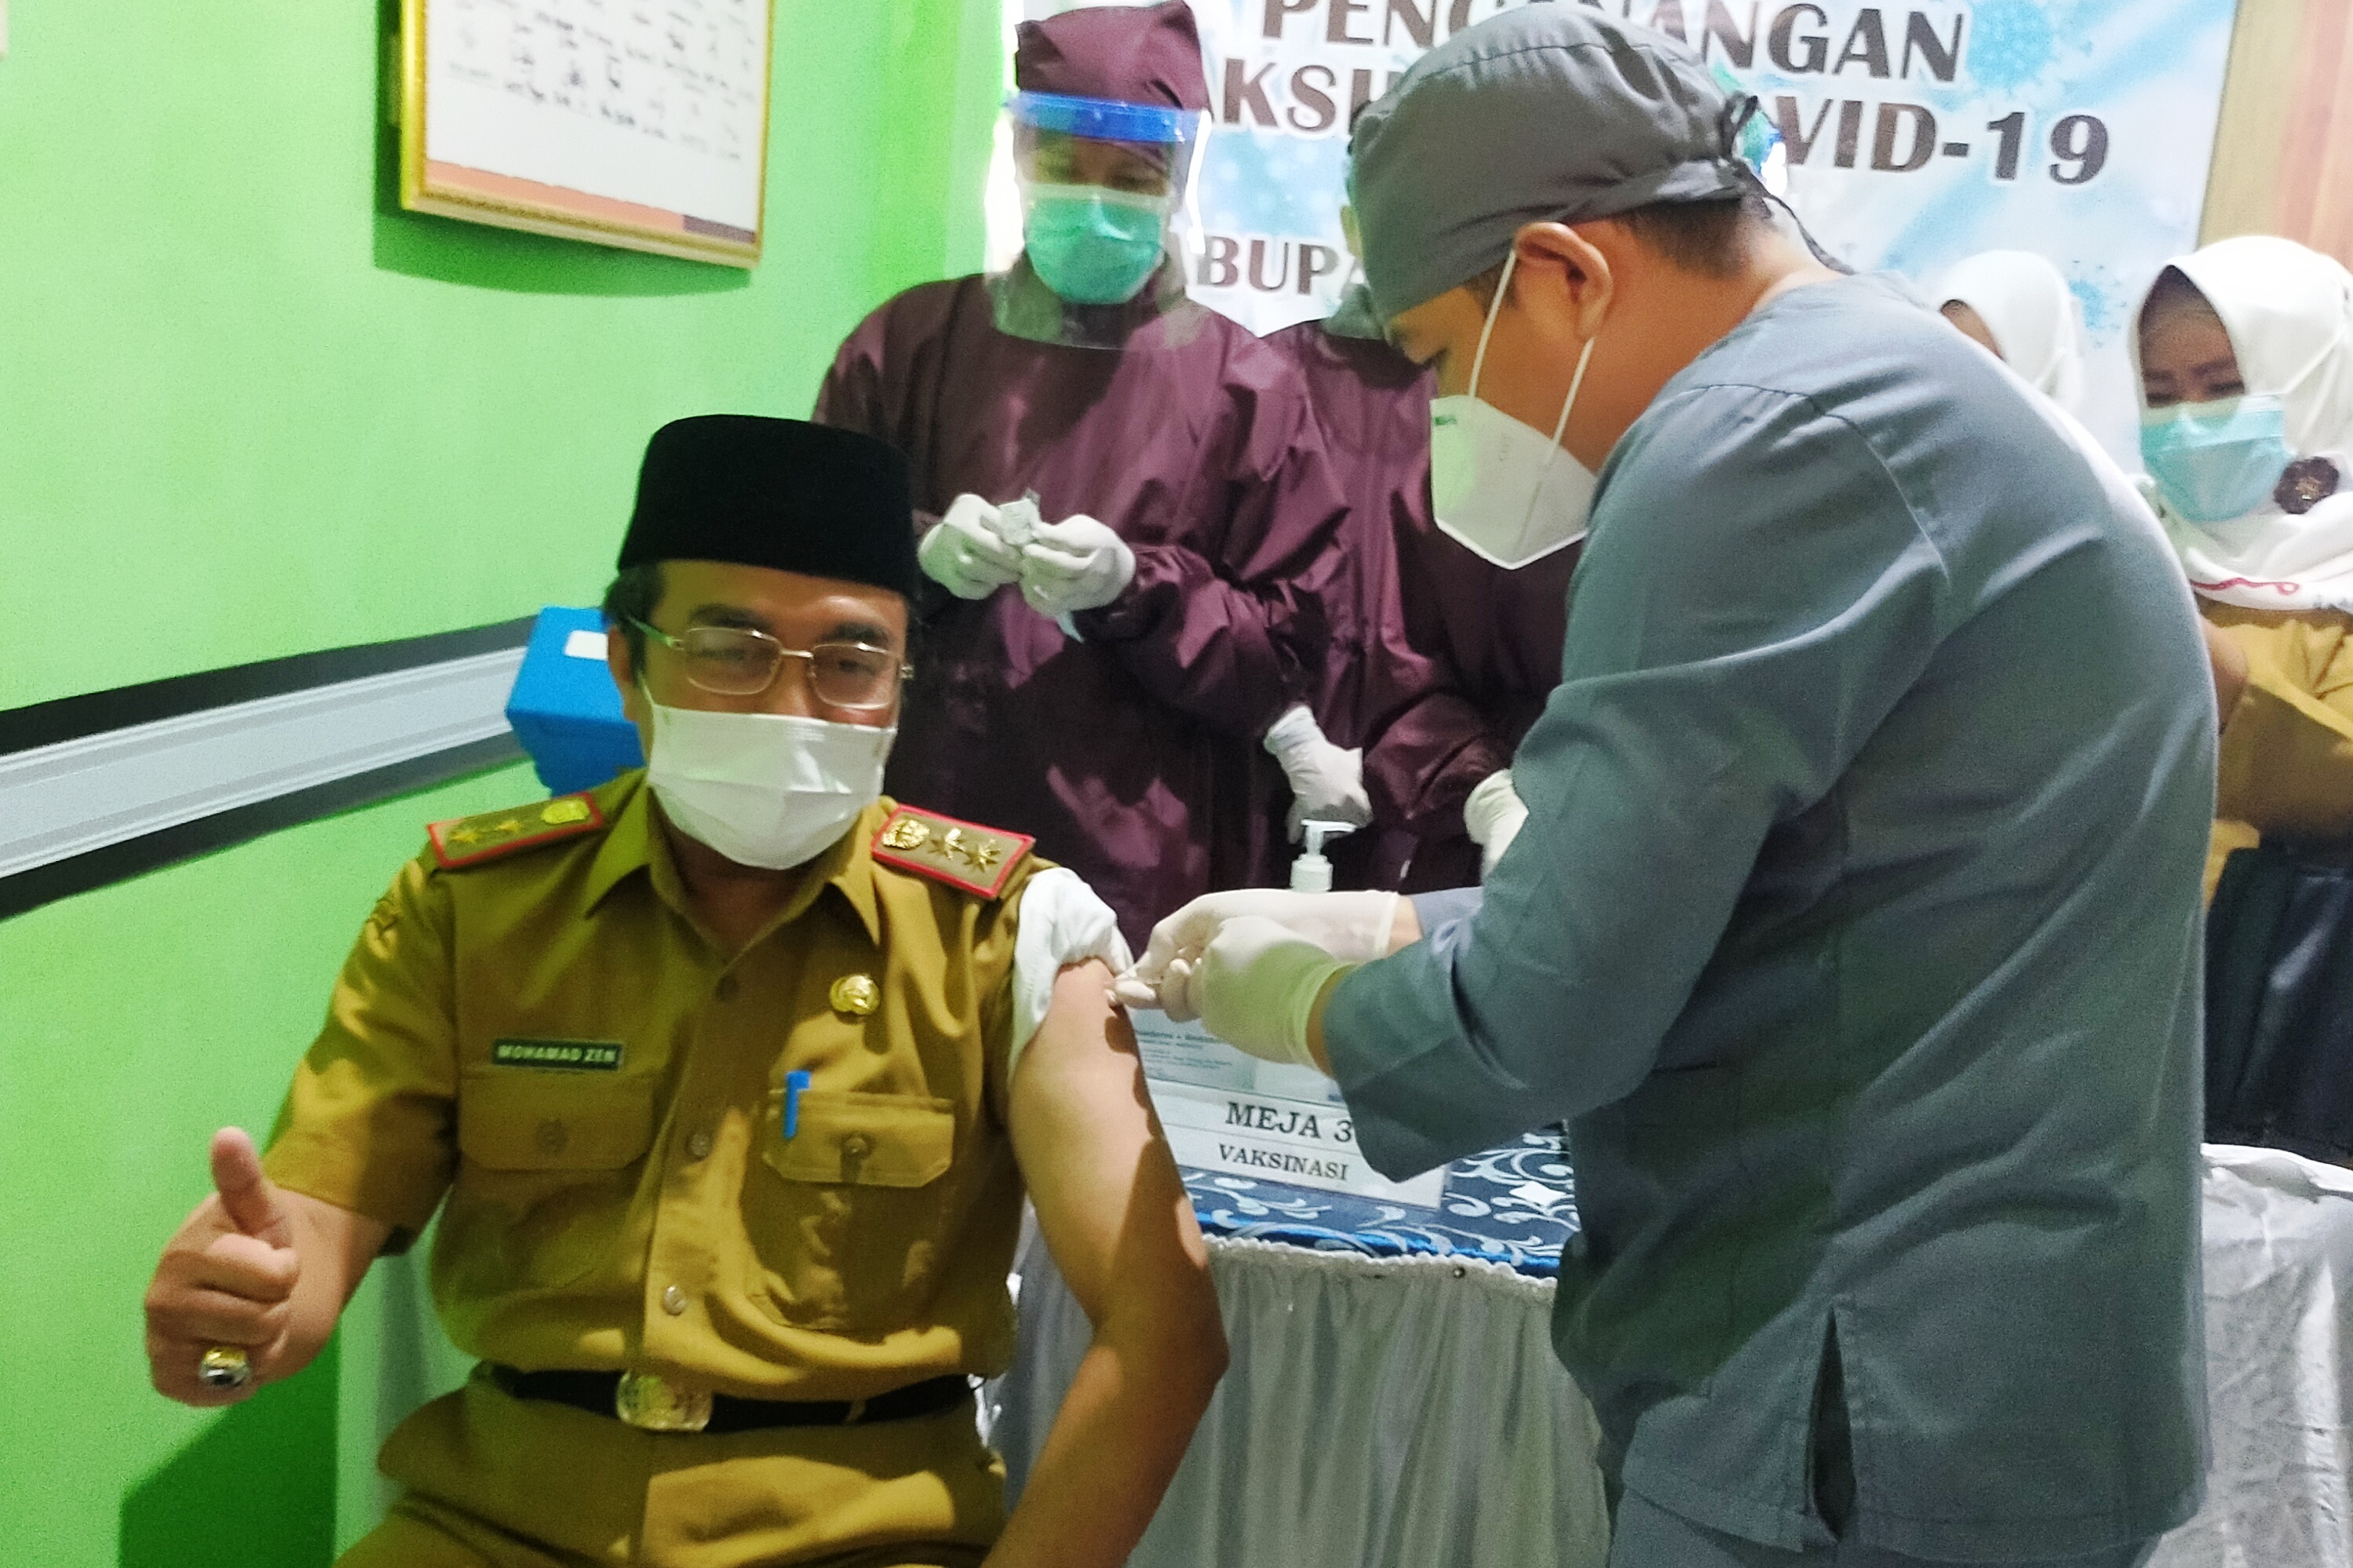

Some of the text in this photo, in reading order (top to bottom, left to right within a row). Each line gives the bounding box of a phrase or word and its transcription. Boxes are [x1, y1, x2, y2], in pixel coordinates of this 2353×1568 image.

[1775, 95, 2109, 185] VID-19
[1224, 1100, 1352, 1143] MEJA 3
[1218, 1143, 1349, 1180] VAKSINASI
